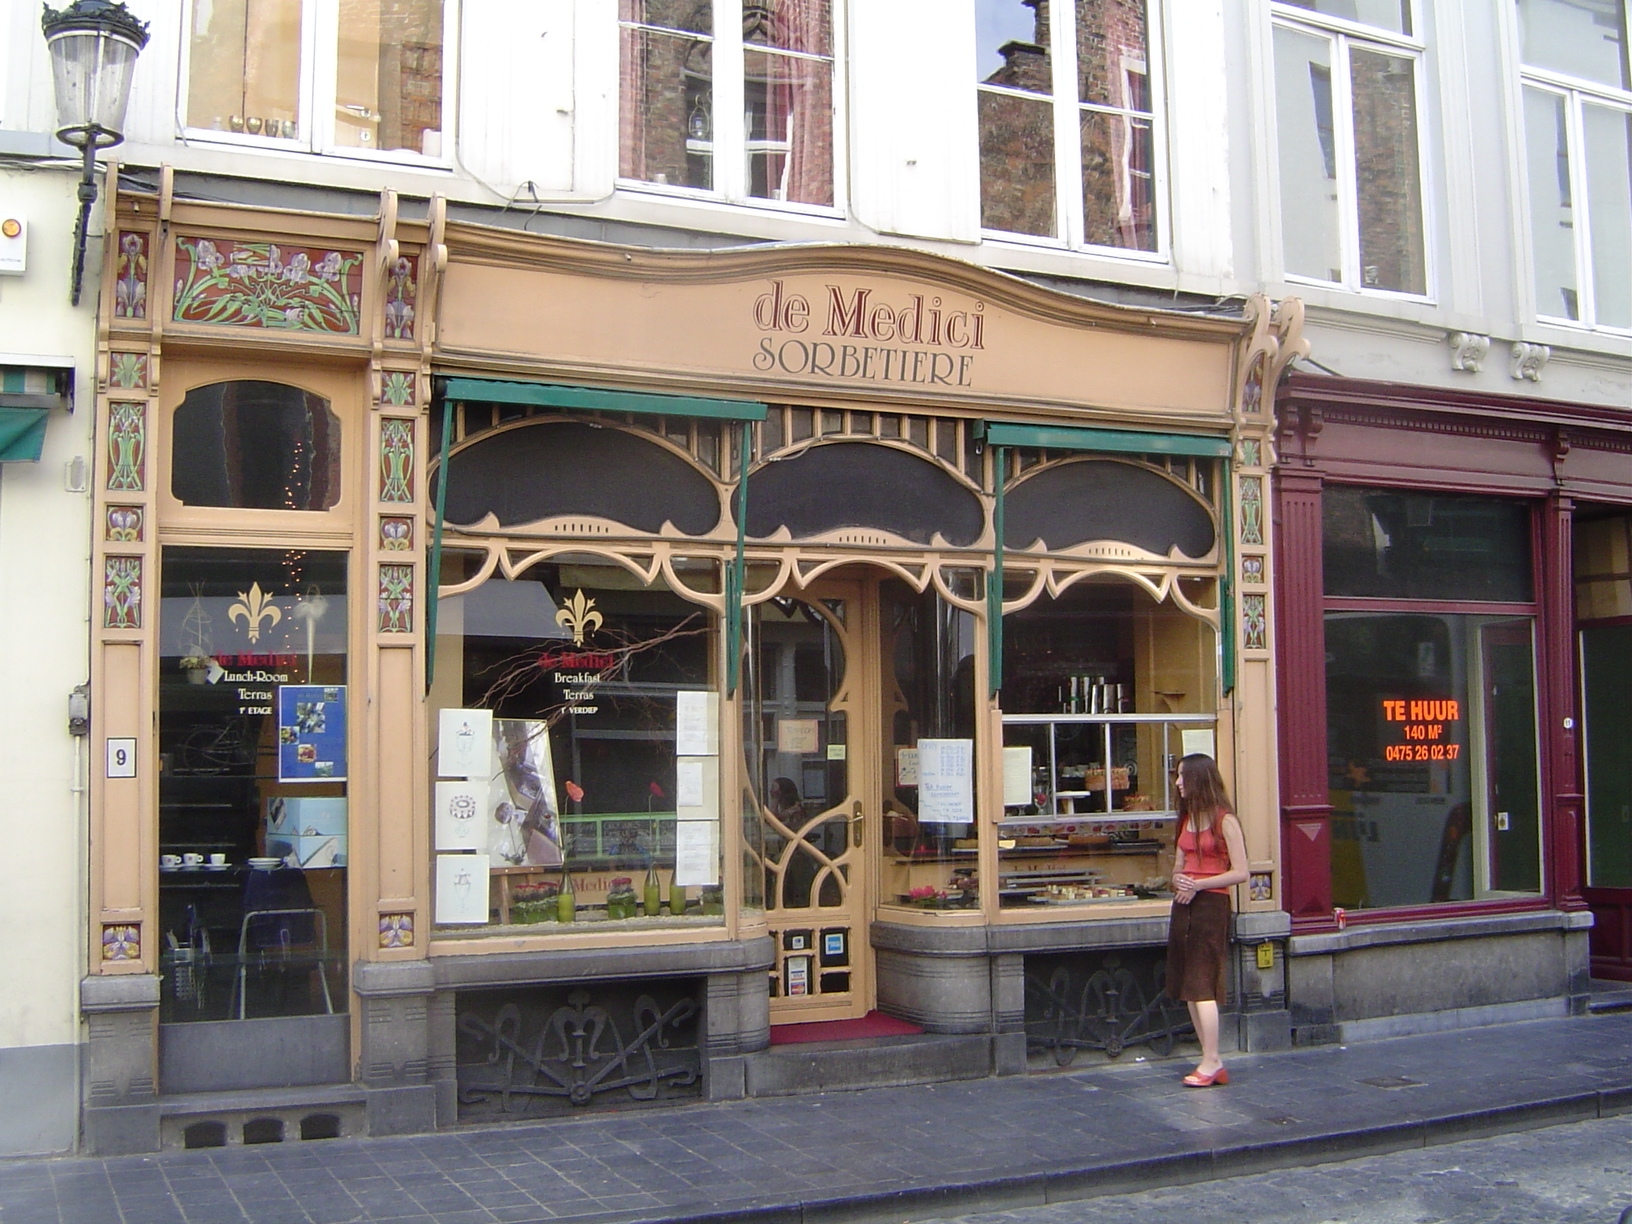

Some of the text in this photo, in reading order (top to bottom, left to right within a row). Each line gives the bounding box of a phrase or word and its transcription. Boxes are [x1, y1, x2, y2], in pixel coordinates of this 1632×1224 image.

[753, 279, 985, 350] de Medici
[752, 337, 974, 388] SORBETIERE
[224, 670, 289, 682] Lunch-Room
[554, 672, 600, 683] Breakfast
[238, 688, 273, 700] Terras
[563, 689, 594, 700] Terras
[248, 706, 273, 715] ETAGE
[569, 706, 598, 714] VERDIEP
[1383, 700, 1459, 721] TE HUUR
[1404, 725, 1425, 740] 140
[116, 748, 127, 766] 9
[1386, 744, 1460, 761] 0475 26 02 37
